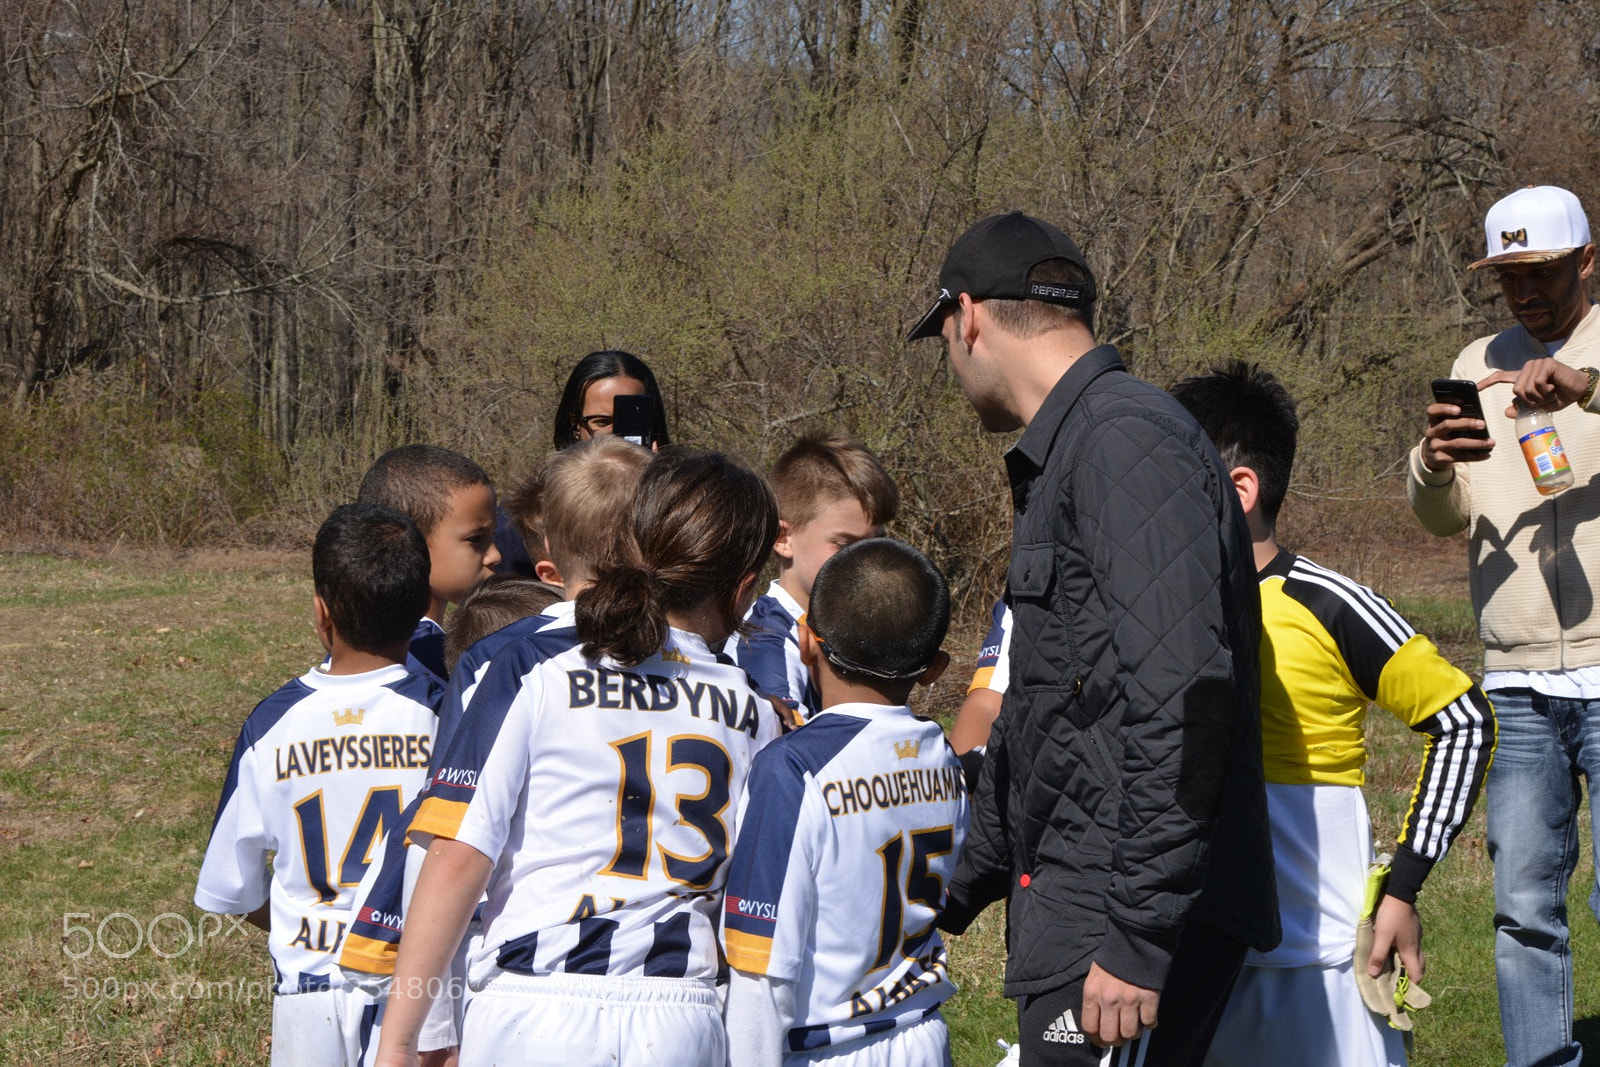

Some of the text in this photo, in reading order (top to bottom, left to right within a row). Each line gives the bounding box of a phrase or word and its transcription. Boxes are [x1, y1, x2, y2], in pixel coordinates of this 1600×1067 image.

[1031, 284, 1080, 299] REFEREE
[566, 667, 760, 740] BERDYNA
[275, 734, 432, 782] LAVEYSSIERES
[446, 766, 478, 787] WYSL
[596, 729, 733, 891] 13
[293, 784, 403, 906] 14
[744, 900, 777, 920] WYSL
[865, 824, 954, 975] 15
[382, 911, 405, 930] WY
[1043, 1029, 1085, 1044] adidas
